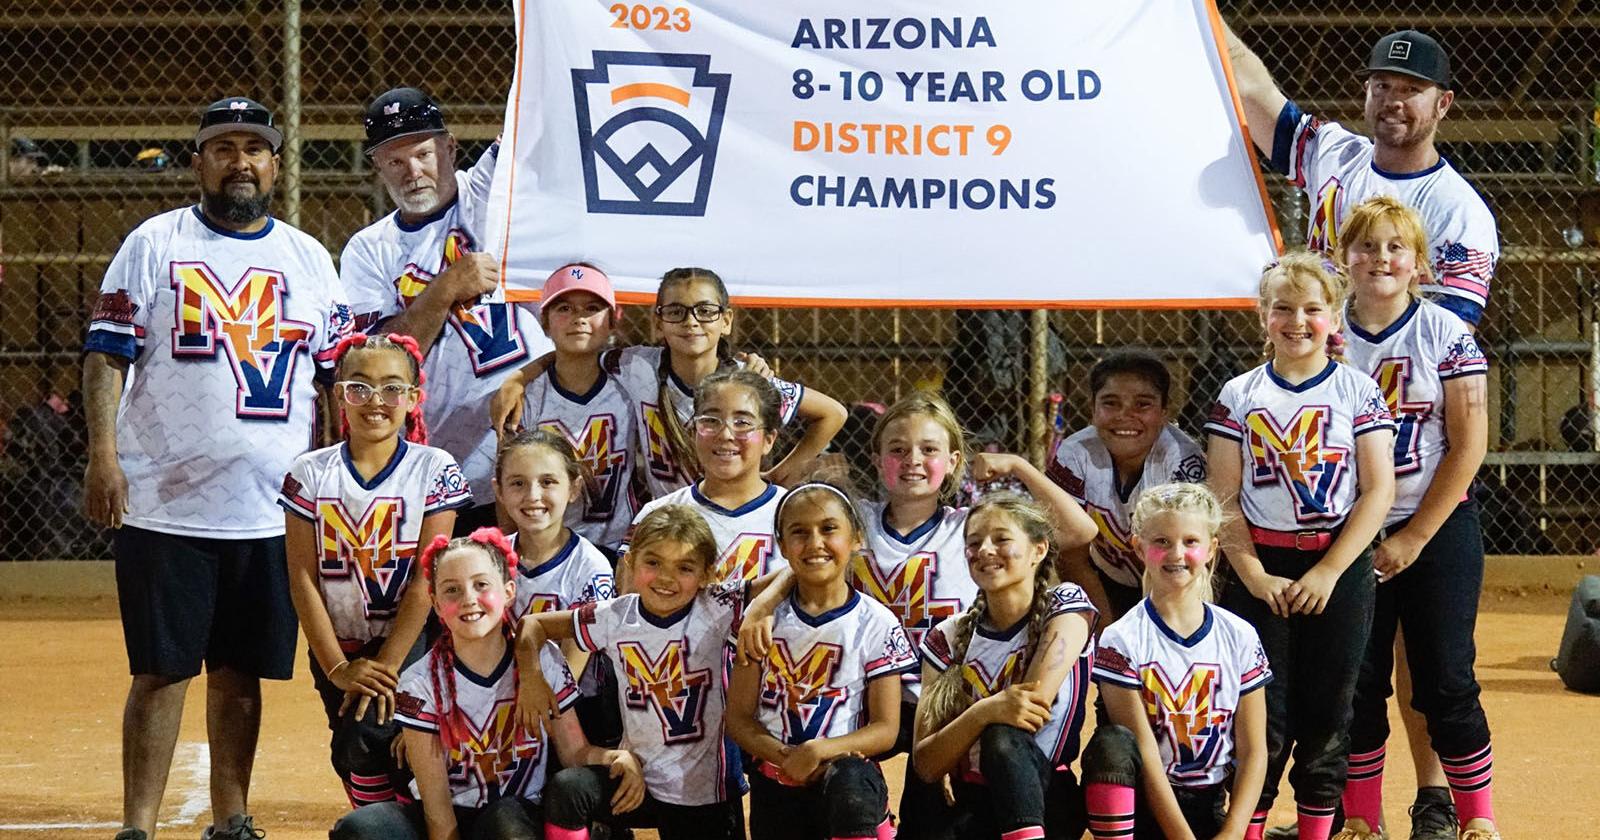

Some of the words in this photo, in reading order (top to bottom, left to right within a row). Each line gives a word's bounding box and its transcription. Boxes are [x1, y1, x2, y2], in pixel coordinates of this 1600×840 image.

[611, 4, 691, 32] 2023
[791, 17, 996, 49] ARIZONA
[793, 69, 883, 101] 8-10
[896, 72, 1006, 102] YEAR
[1021, 70, 1101, 101] OLD
[793, 121, 974, 156] DISTRICT
[987, 125, 1011, 155] 9
[791, 175, 1056, 209] CHAMPIONS
[571, 269, 584, 280] MV
[170, 261, 316, 419] MV
[1245, 405, 1350, 524] MV
[315, 497, 419, 620] MV
[617, 635, 713, 746] MV
[760, 637, 848, 746] MV
[1139, 661, 1232, 780] MV
